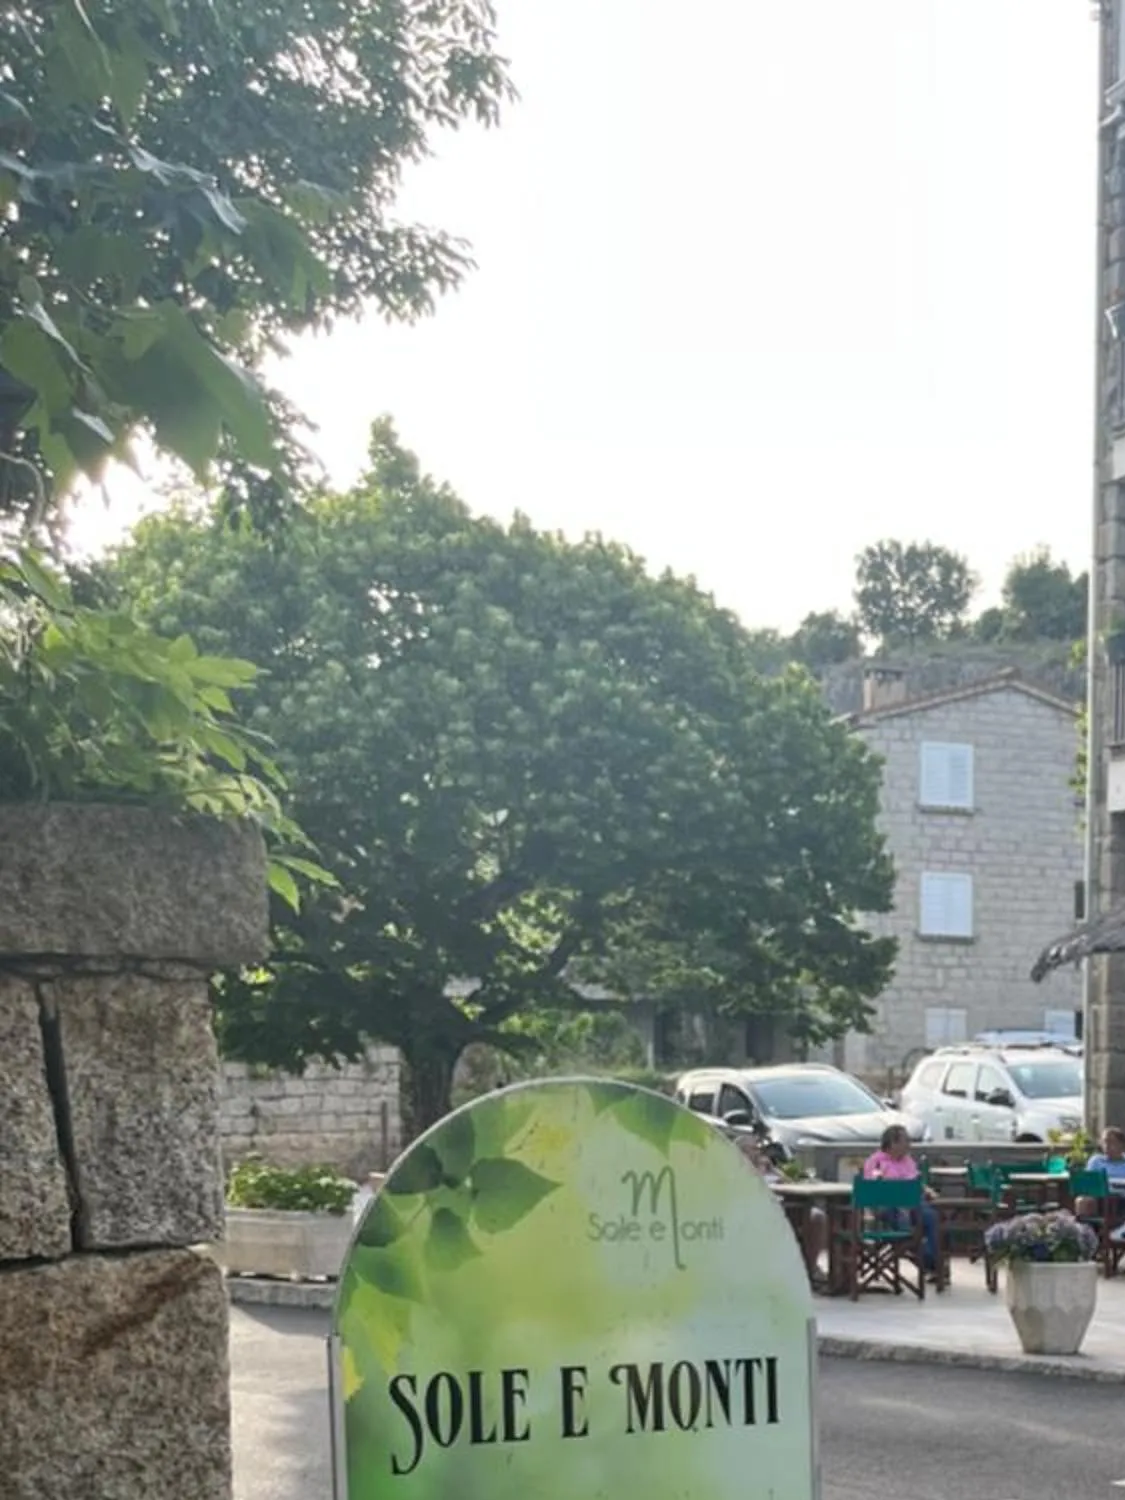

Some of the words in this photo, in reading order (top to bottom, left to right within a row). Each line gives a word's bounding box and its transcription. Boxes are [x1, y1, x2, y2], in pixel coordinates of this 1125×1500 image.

[586, 1211, 641, 1242] Sole
[649, 1220, 667, 1241] e
[388, 1368, 532, 1475] SOLE
[560, 1365, 590, 1439] E
[608, 1356, 780, 1435] MONTI
